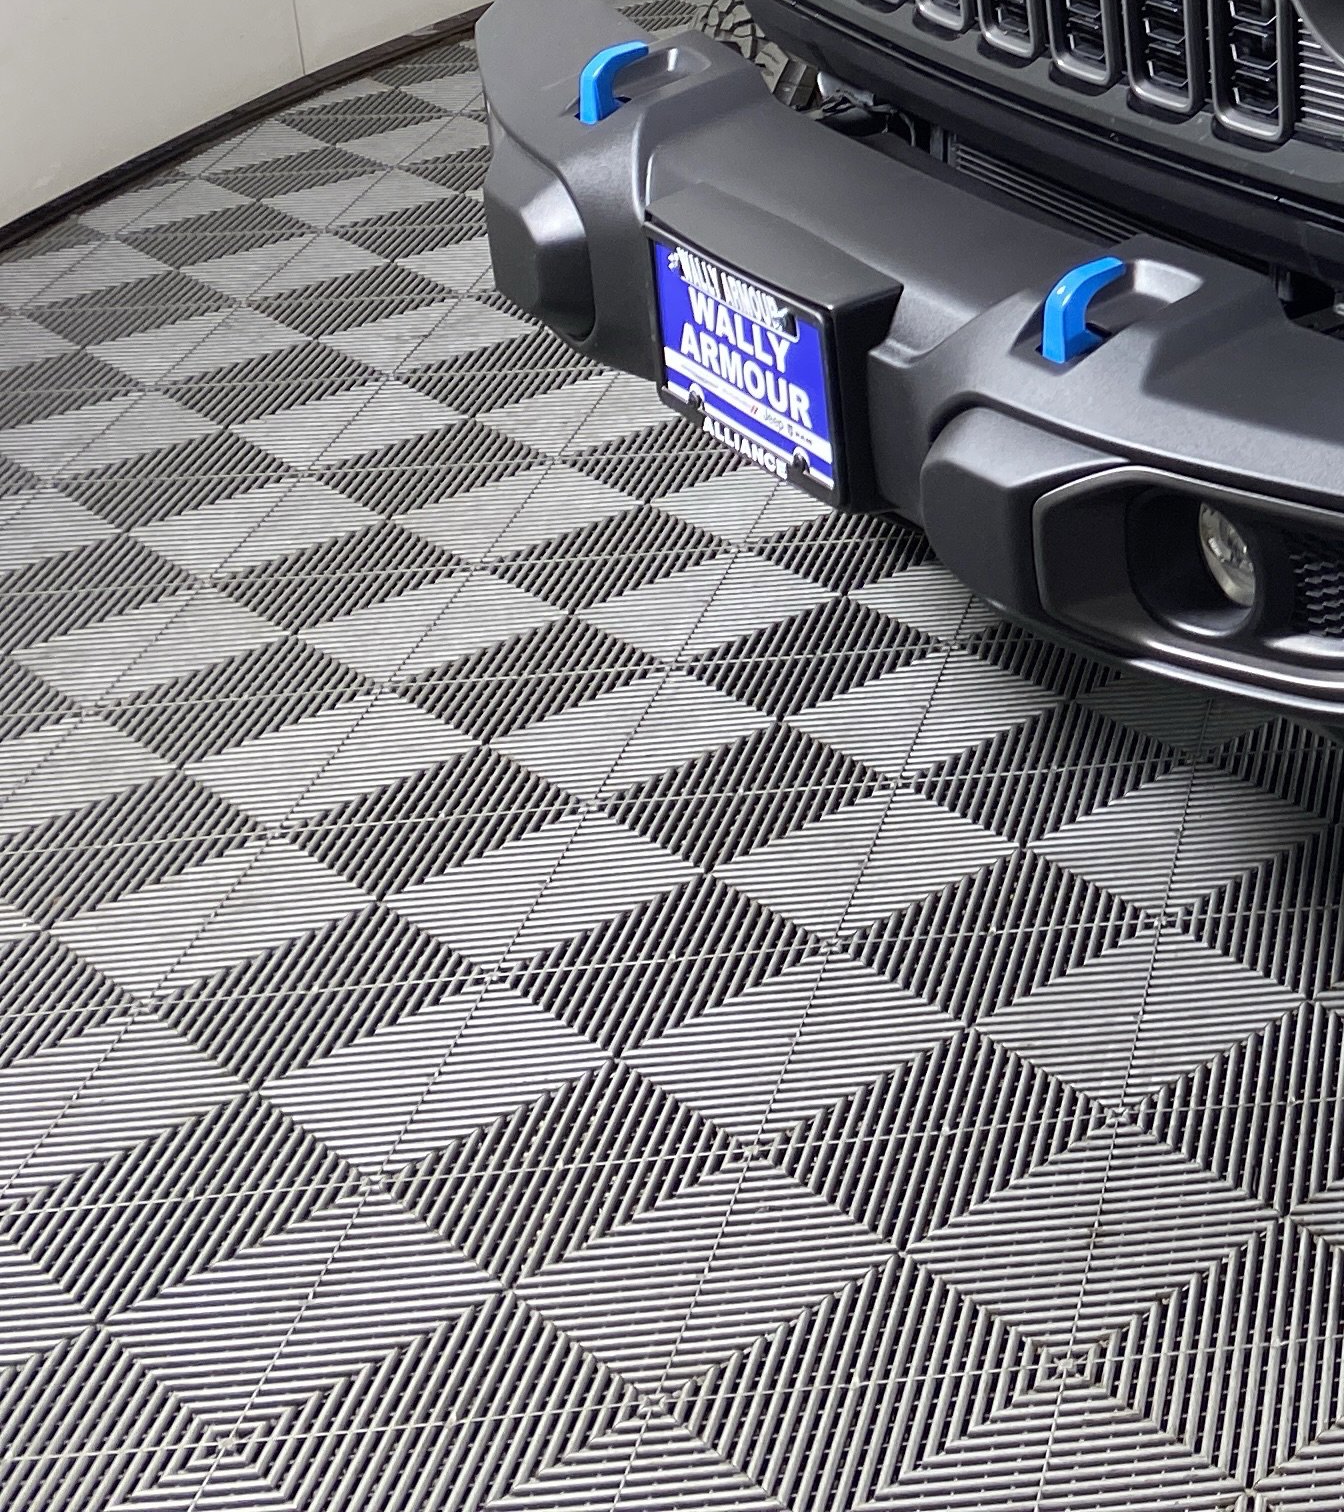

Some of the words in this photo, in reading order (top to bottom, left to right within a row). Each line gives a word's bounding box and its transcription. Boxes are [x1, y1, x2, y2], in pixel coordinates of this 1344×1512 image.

[677, 247, 722, 302] WALLY
[721, 271, 778, 328] ARMOUR
[688, 286, 791, 374] WALLY
[680, 322, 813, 429] ARMOUR
[703, 415, 788, 479] ALLIANCE
